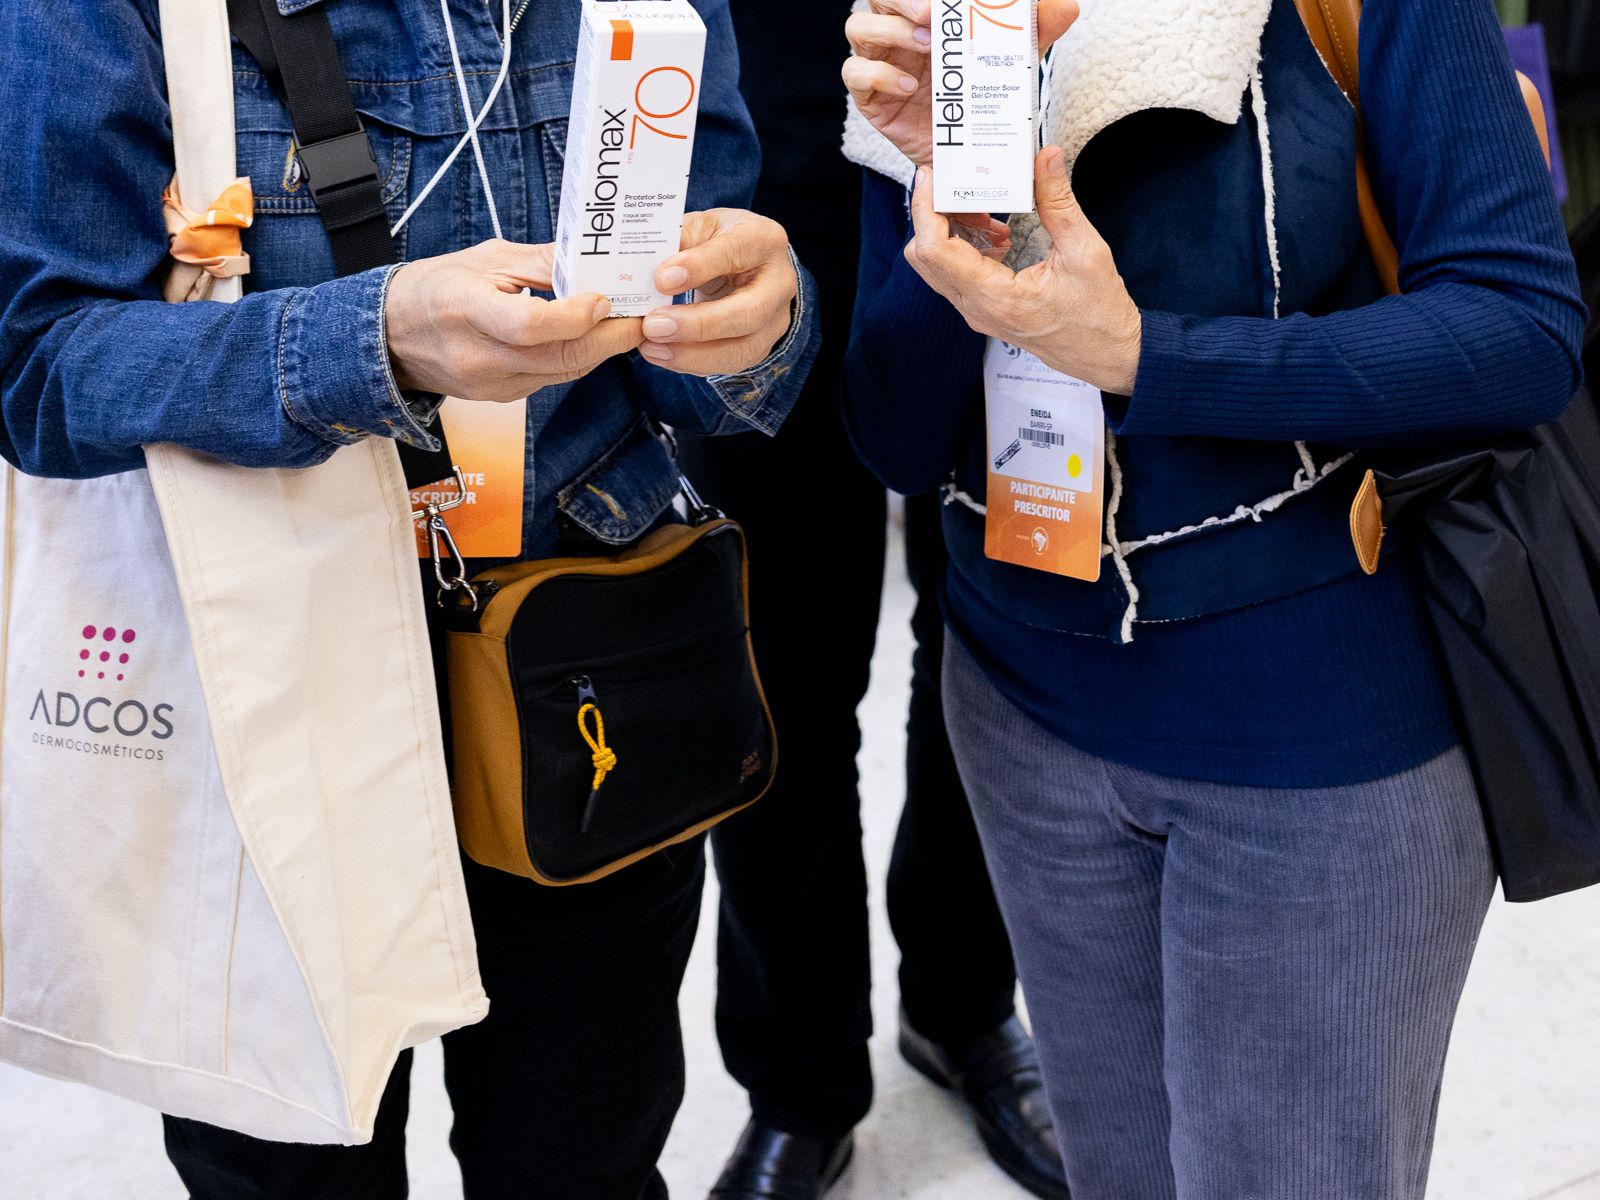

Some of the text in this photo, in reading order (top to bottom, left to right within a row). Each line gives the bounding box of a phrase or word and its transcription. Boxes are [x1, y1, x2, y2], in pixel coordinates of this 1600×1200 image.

[936, 0, 964, 147] Heliomax
[630, 66, 695, 150] 70
[581, 108, 627, 256] Heliomax
[619, 273, 634, 282] 50g
[1030, 408, 1052, 419] ENEIDA
[409, 491, 477, 505] SCRITR
[1010, 481, 1076, 505] PARTICIPANTE
[1013, 499, 1071, 523] PRESCRITOR
[29, 687, 174, 740] ADCOS
[32, 732, 164, 761] DERMOCOSMÉTICOS
